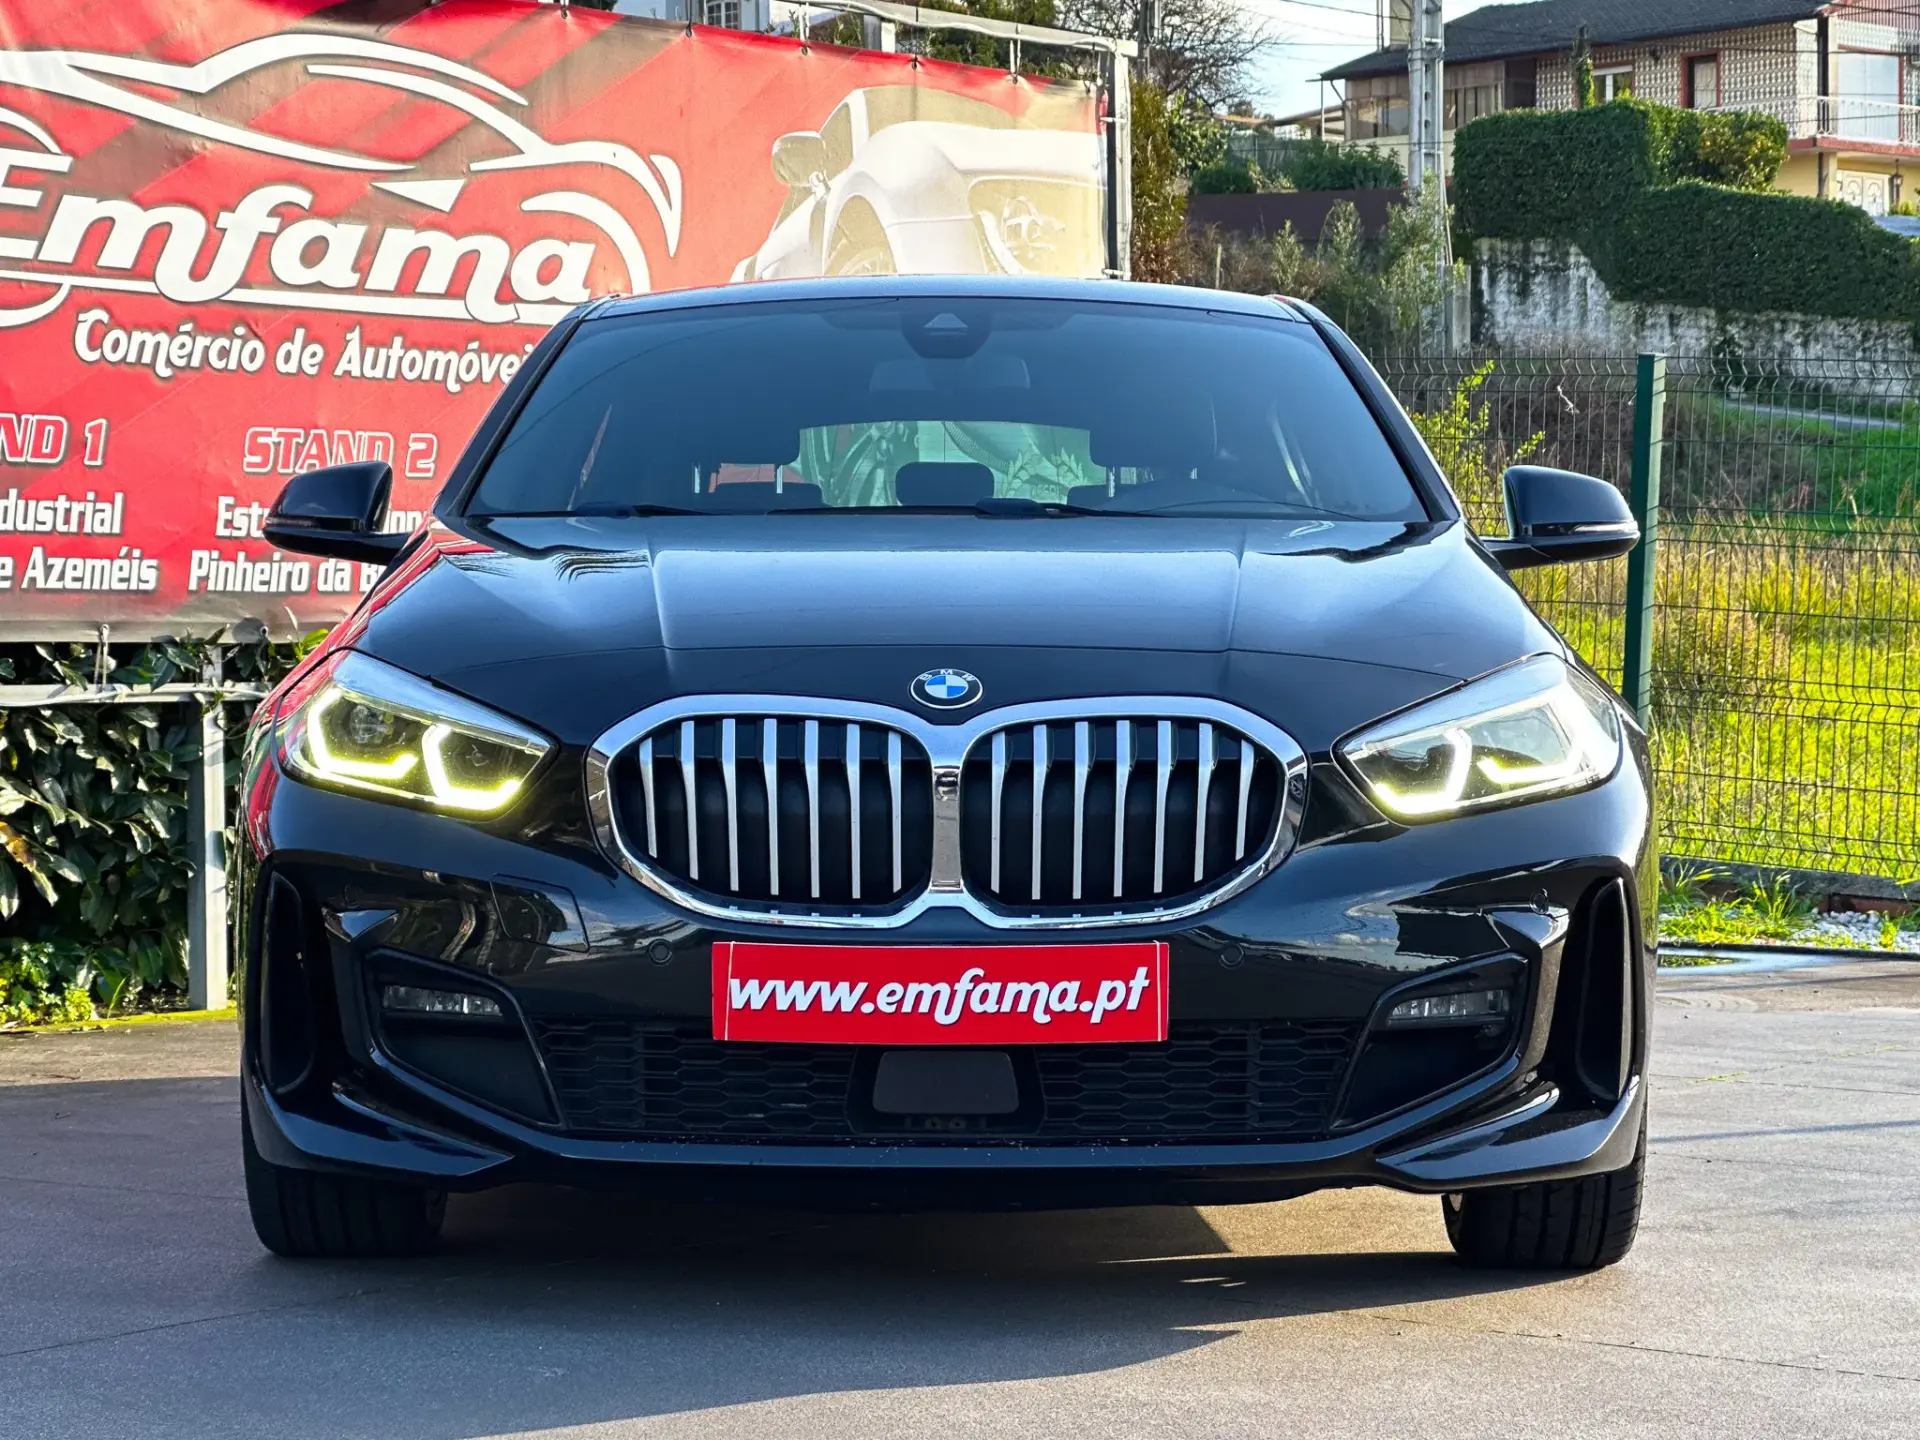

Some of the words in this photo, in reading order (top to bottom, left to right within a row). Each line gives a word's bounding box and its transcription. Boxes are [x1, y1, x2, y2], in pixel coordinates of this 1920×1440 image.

[0, 147, 597, 322] Emfama
[74, 308, 266, 378] Comércio
[275, 328, 324, 375] de
[0, 413, 68, 463] ND
[83, 418, 108, 465] 1
[243, 427, 395, 474] STAND
[405, 433, 438, 478] 2
[0, 488, 124, 534] dustrial
[21, 546, 159, 591] Azeméis
[189, 549, 309, 592] Pinheiro
[317, 558, 352, 592] da
[919, 669, 976, 681] BMW
[730, 966, 1150, 1025] www.emfama.pt
